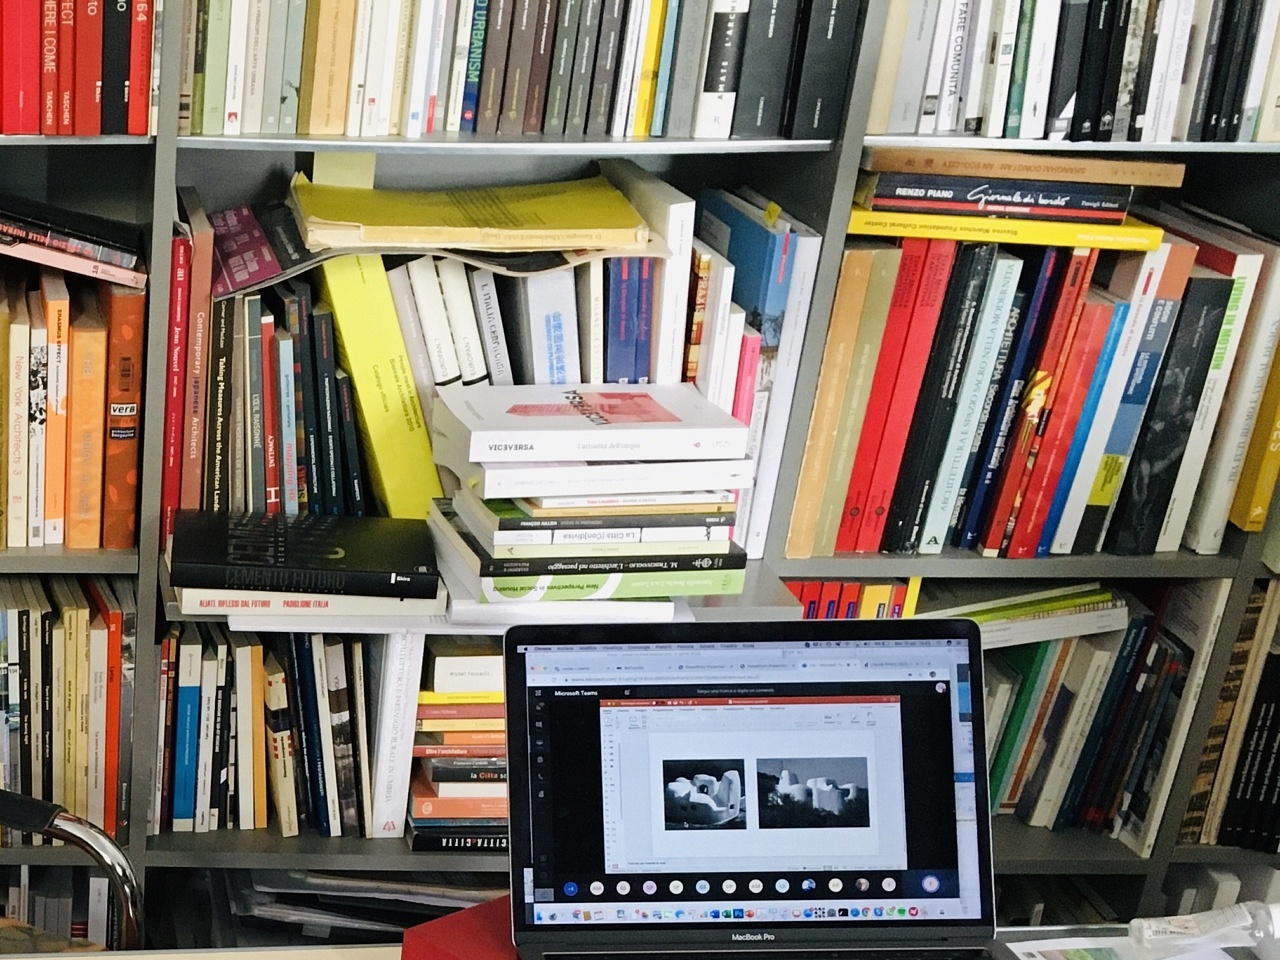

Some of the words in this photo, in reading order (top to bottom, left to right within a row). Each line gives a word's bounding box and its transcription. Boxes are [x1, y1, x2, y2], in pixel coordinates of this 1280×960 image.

[953, 2, 969, 31] FARE
[45, 37, 57, 74] COME
[468, 11, 487, 82] URBANISM
[946, 35, 964, 97] COMUNITÀ
[63, 90, 71, 126] TASCHEN
[895, 186, 925, 198] RENZO
[927, 188, 954, 199] PIANO
[1224, 276, 1247, 311] LIVING
[174, 326, 182, 345] Jean
[1221, 314, 1237, 326] IN
[172, 345, 182, 372] Nouvel
[193, 312, 206, 376] Contemporary
[1211, 328, 1233, 371] MOTION
[15, 355, 24, 379] New
[218, 357, 227, 381] Taking
[15, 385, 24, 407] York
[217, 382, 226, 414] Measures
[14, 413, 24, 464] Architects
[190, 417, 200, 460] Architects
[216, 441, 224, 453] the
[215, 455, 223, 488] American
[285, 442, 295, 486] mapping
[554, 689, 580, 697] Microsoft
[731, 933, 762, 941] MacBook
[763, 933, 776, 941] Pro
